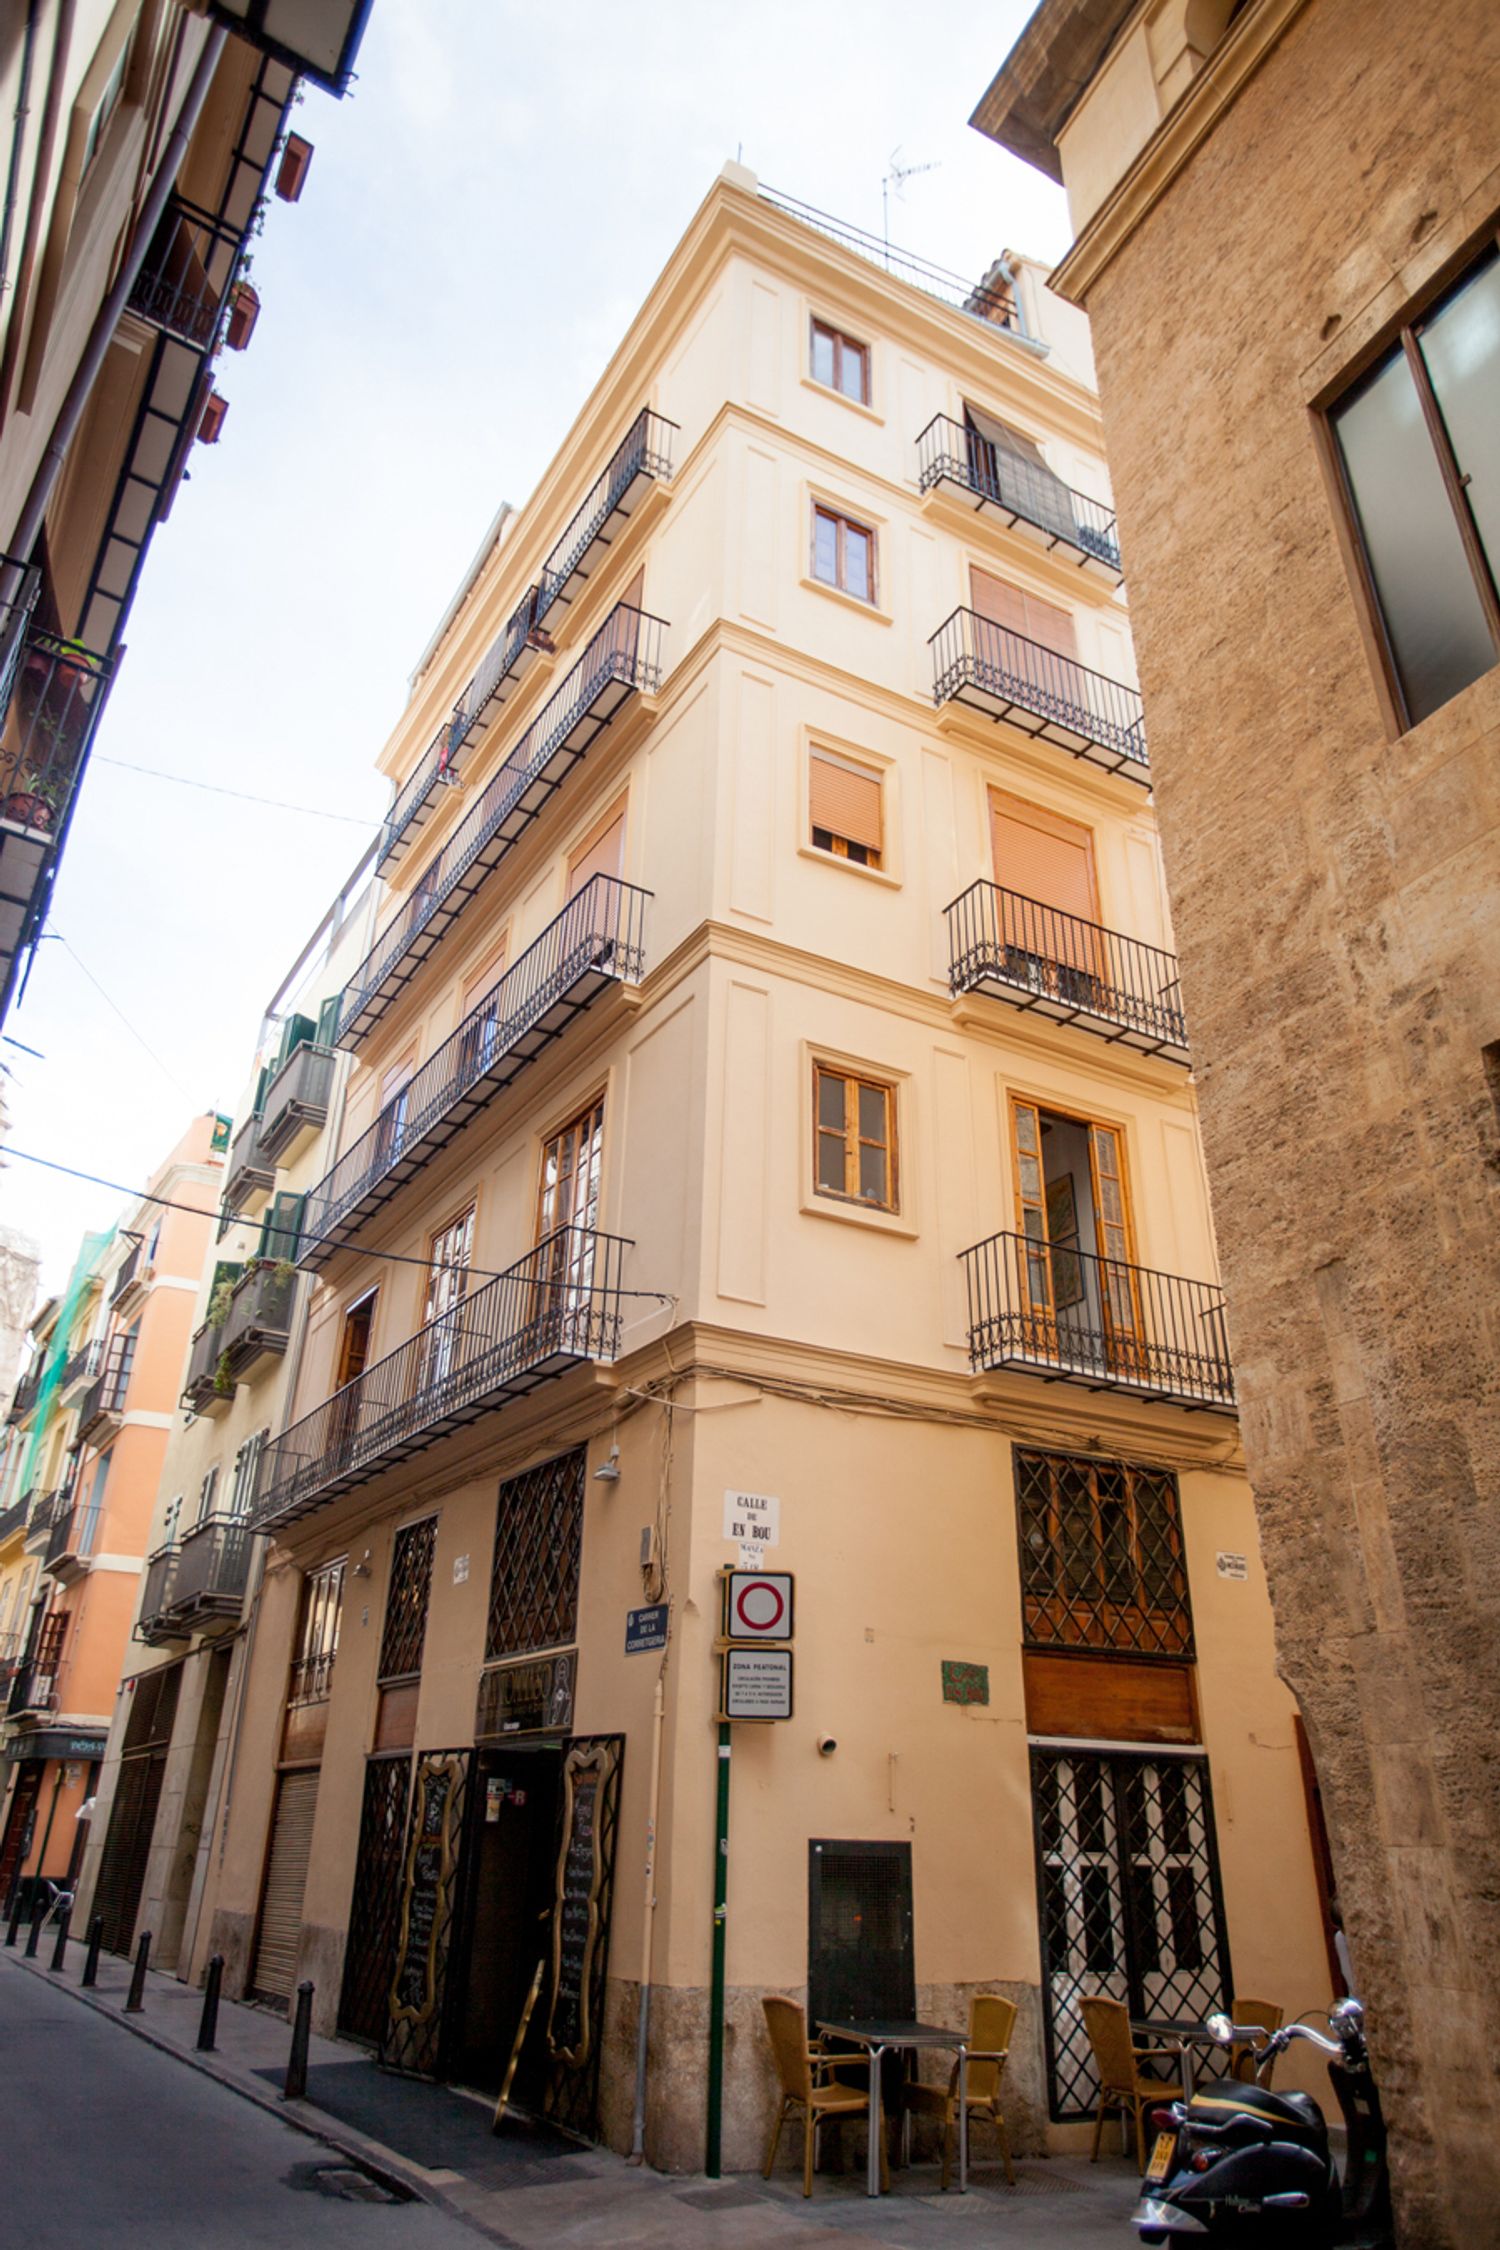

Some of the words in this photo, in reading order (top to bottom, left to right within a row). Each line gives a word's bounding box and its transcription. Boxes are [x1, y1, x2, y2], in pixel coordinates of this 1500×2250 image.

[737, 1496, 768, 1511] CALLE
[747, 1512, 757, 1521] DE
[732, 1522, 746, 1537] EN
[752, 1525, 771, 1541] BOU
[638, 1610, 659, 1623] CARRER
[640, 1624, 648, 1634] DE
[648, 1622, 656, 1633] LA
[753, 1663, 787, 1671] PEATONAL
